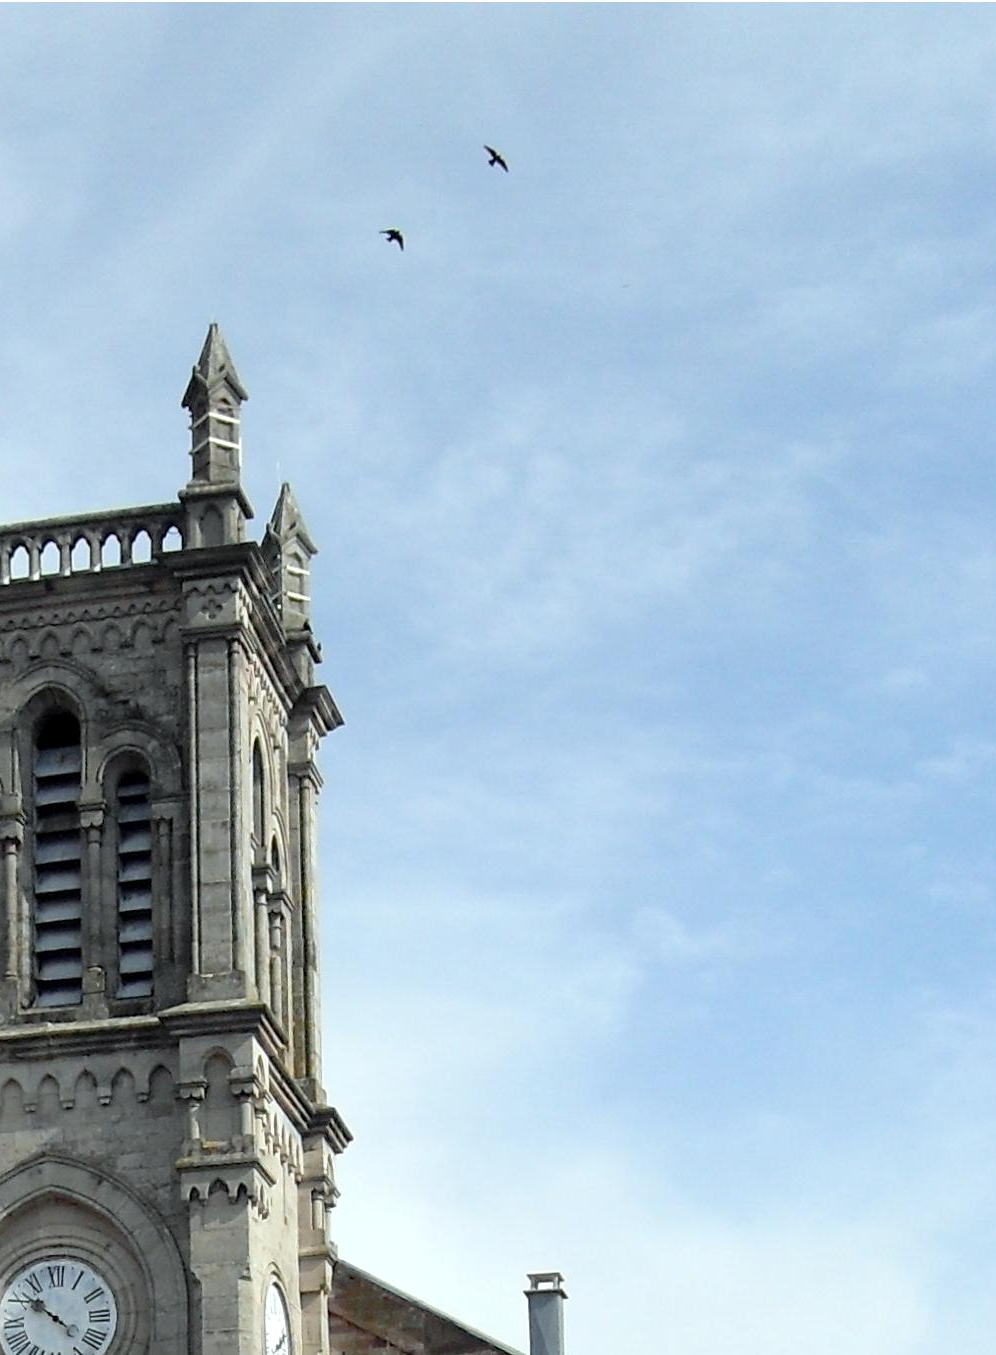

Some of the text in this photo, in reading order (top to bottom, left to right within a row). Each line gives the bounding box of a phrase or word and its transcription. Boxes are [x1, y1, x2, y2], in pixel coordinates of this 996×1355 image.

[47, 1265, 65, 1288] XII
[71, 1270, 84, 1290] I
[84, 1287, 104, 1304] II
[88, 1309, 110, 1323] III
